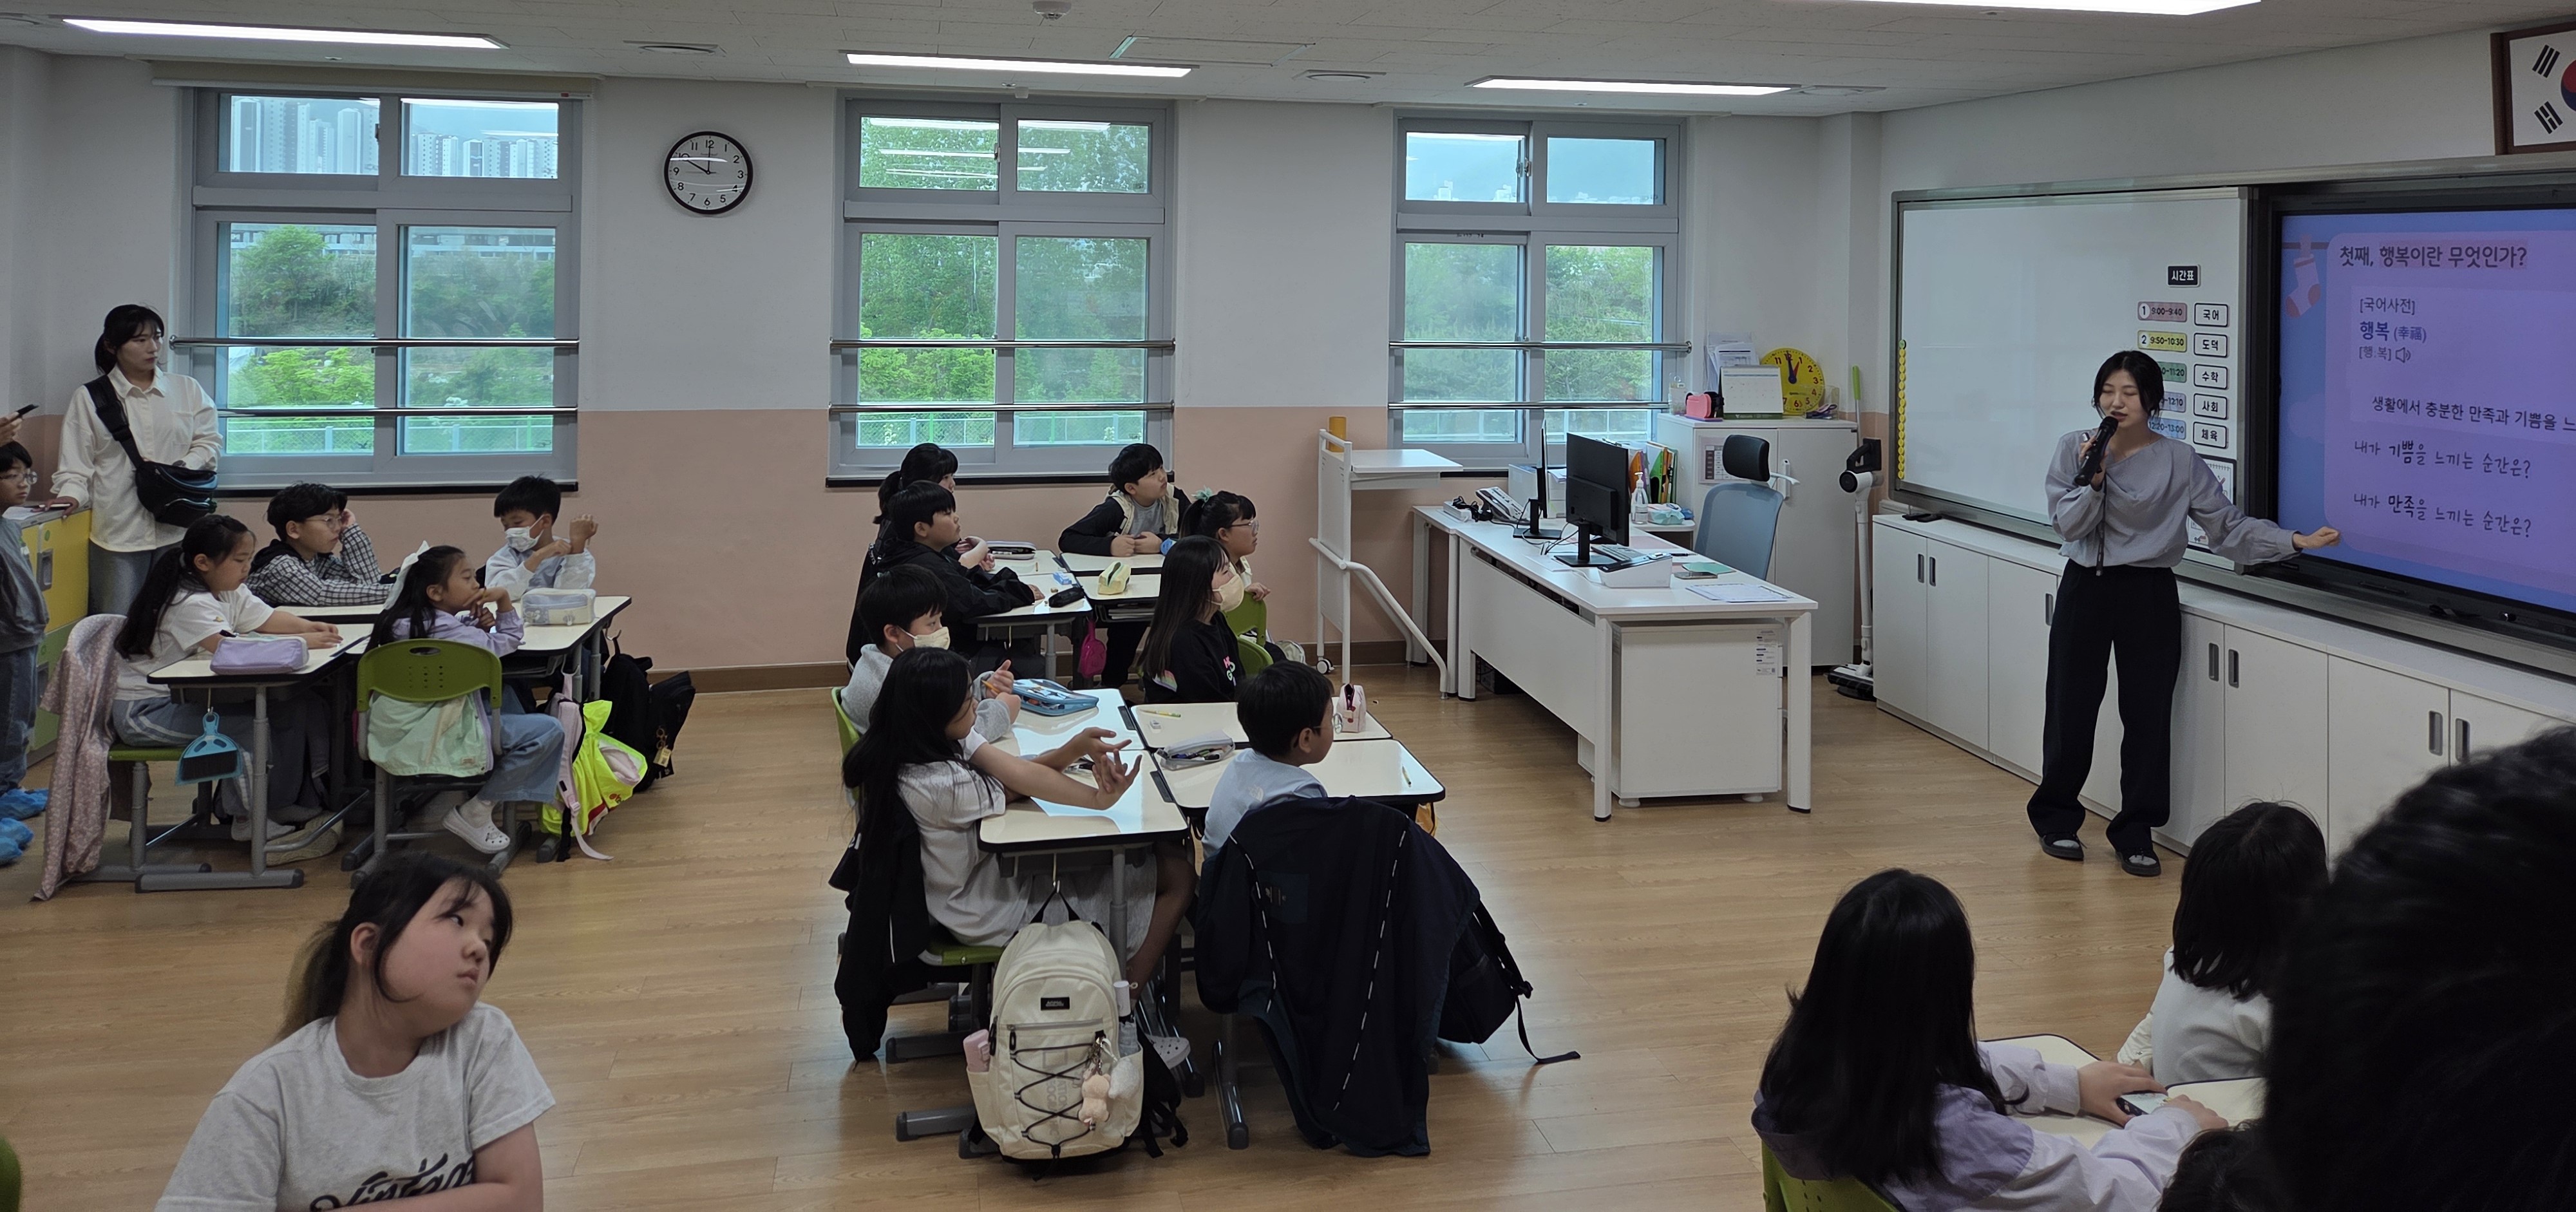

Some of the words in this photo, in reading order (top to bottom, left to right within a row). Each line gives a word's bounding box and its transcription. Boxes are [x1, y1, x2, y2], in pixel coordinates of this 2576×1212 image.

[691, 142, 698, 151] 11
[705, 139, 715, 149] 12
[733, 155, 740, 164] 2
[673, 167, 680, 175] 9
[737, 169, 744, 179] 3
[677, 182, 685, 191] 8
[689, 193, 696, 202] 7
[704, 197, 711, 206] 6
[719, 194, 726, 203] 5
[2340, 245, 2374, 268] 첫째,
[2379, 246, 2443, 268] 행복이란
[2447, 246, 2528, 269] 무엇인가?
[2171, 270, 2194, 281] 시간표
[2142, 306, 2146, 316] 1
[2360, 297, 2416, 315] [국어사전]
[2202, 309, 2219, 321] 국어
[2360, 321, 2390, 341] 행복
[2393, 326, 2427, 343] (幸福)
[2141, 334, 2147, 345] 2
[2202, 339, 2219, 351] 도덕
[1799, 356, 1803, 365] 1
[1807, 365, 1814, 373] 2
[2162, 367, 2185, 377] 0-11:20
[2202, 371, 2219, 383] 수학
[2202, 400, 2219, 413] 사회
[2372, 396, 2421, 416] 생활에서
[2425, 402, 2464, 421] 충분한
[2469, 406, 2510, 426] 만족과
[2514, 410, 2557, 431] 기쁨을
[2201, 428, 2218, 442] 체육
[2354, 440, 2381, 456] 내가
[2389, 440, 2427, 466] 기쁨을
[2434, 451, 2474, 469] 느끼는
[2482, 453, 2531, 479] 순간은?
[2353, 493, 2381, 509] 내가
[2388, 495, 2427, 521] 만족을
[2435, 507, 2474, 527] 느끼는
[2483, 510, 2532, 538] 순간은?
